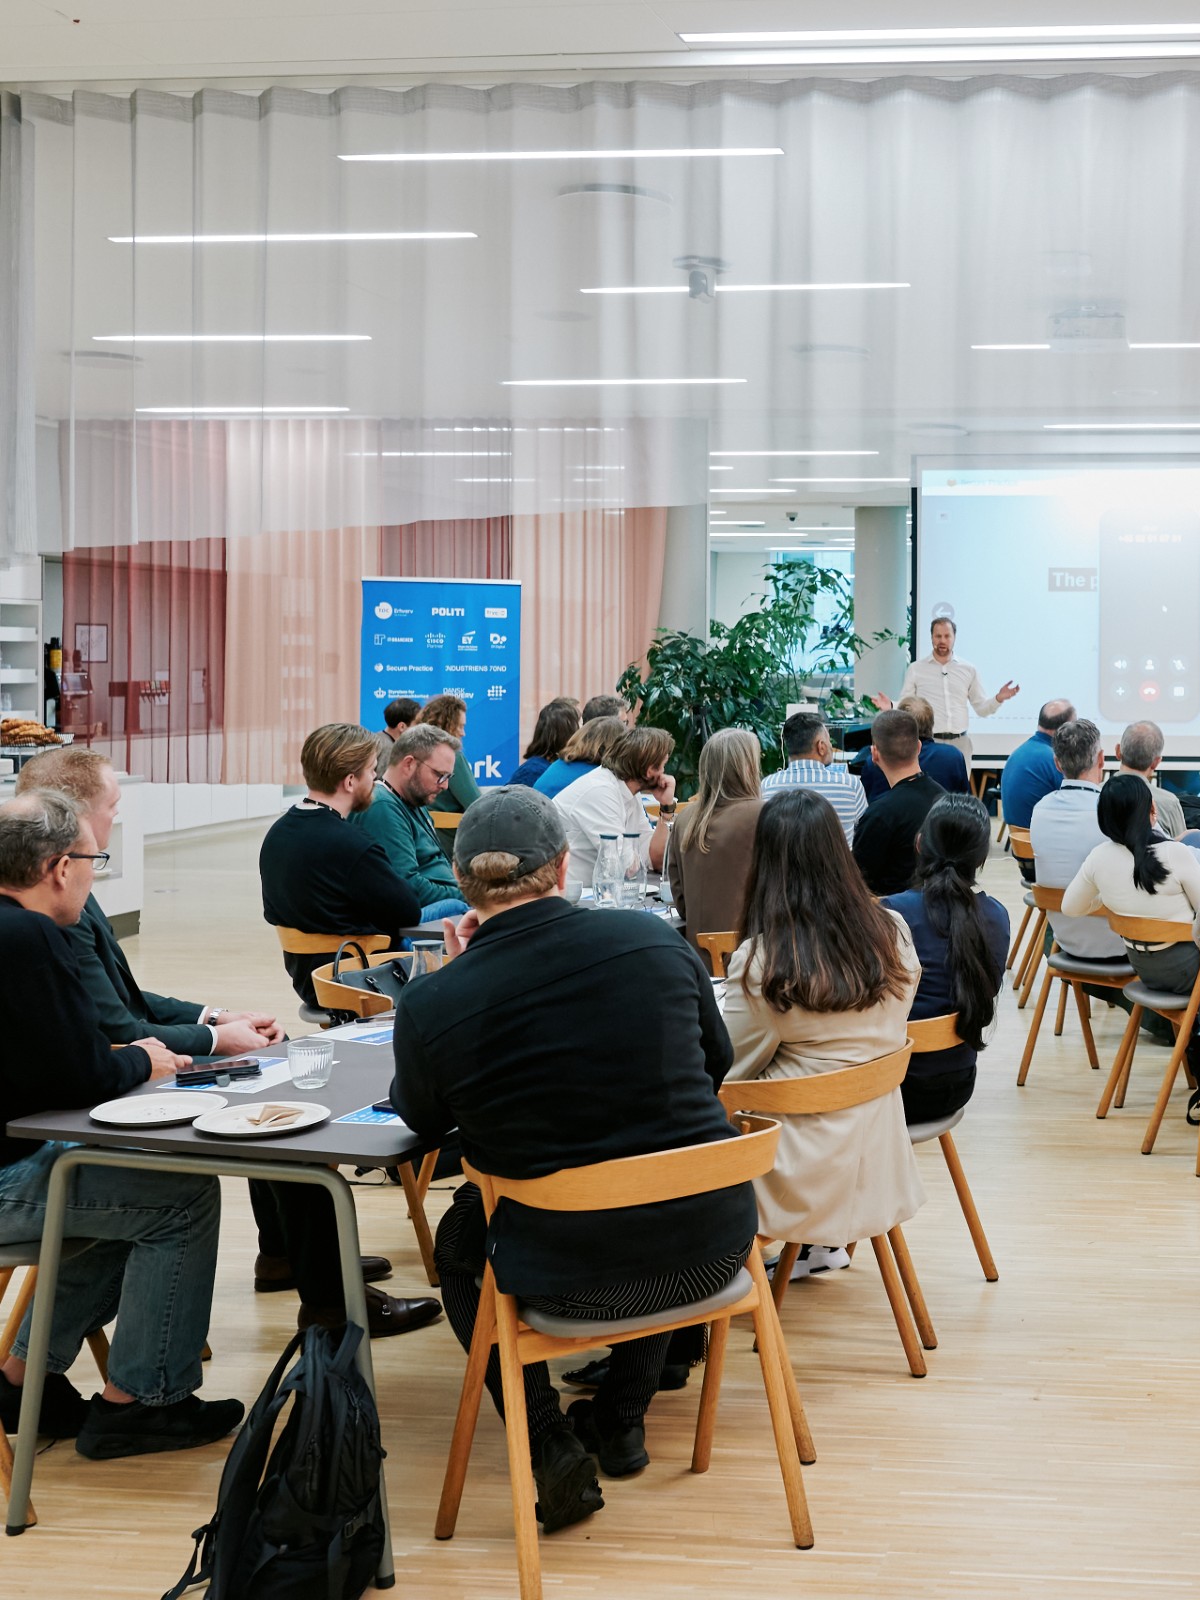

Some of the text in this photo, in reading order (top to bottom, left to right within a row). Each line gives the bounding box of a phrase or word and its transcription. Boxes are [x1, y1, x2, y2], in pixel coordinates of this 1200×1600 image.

[1052, 571, 1086, 588] The
[431, 607, 465, 617] POLITI
[462, 636, 474, 644] EY
